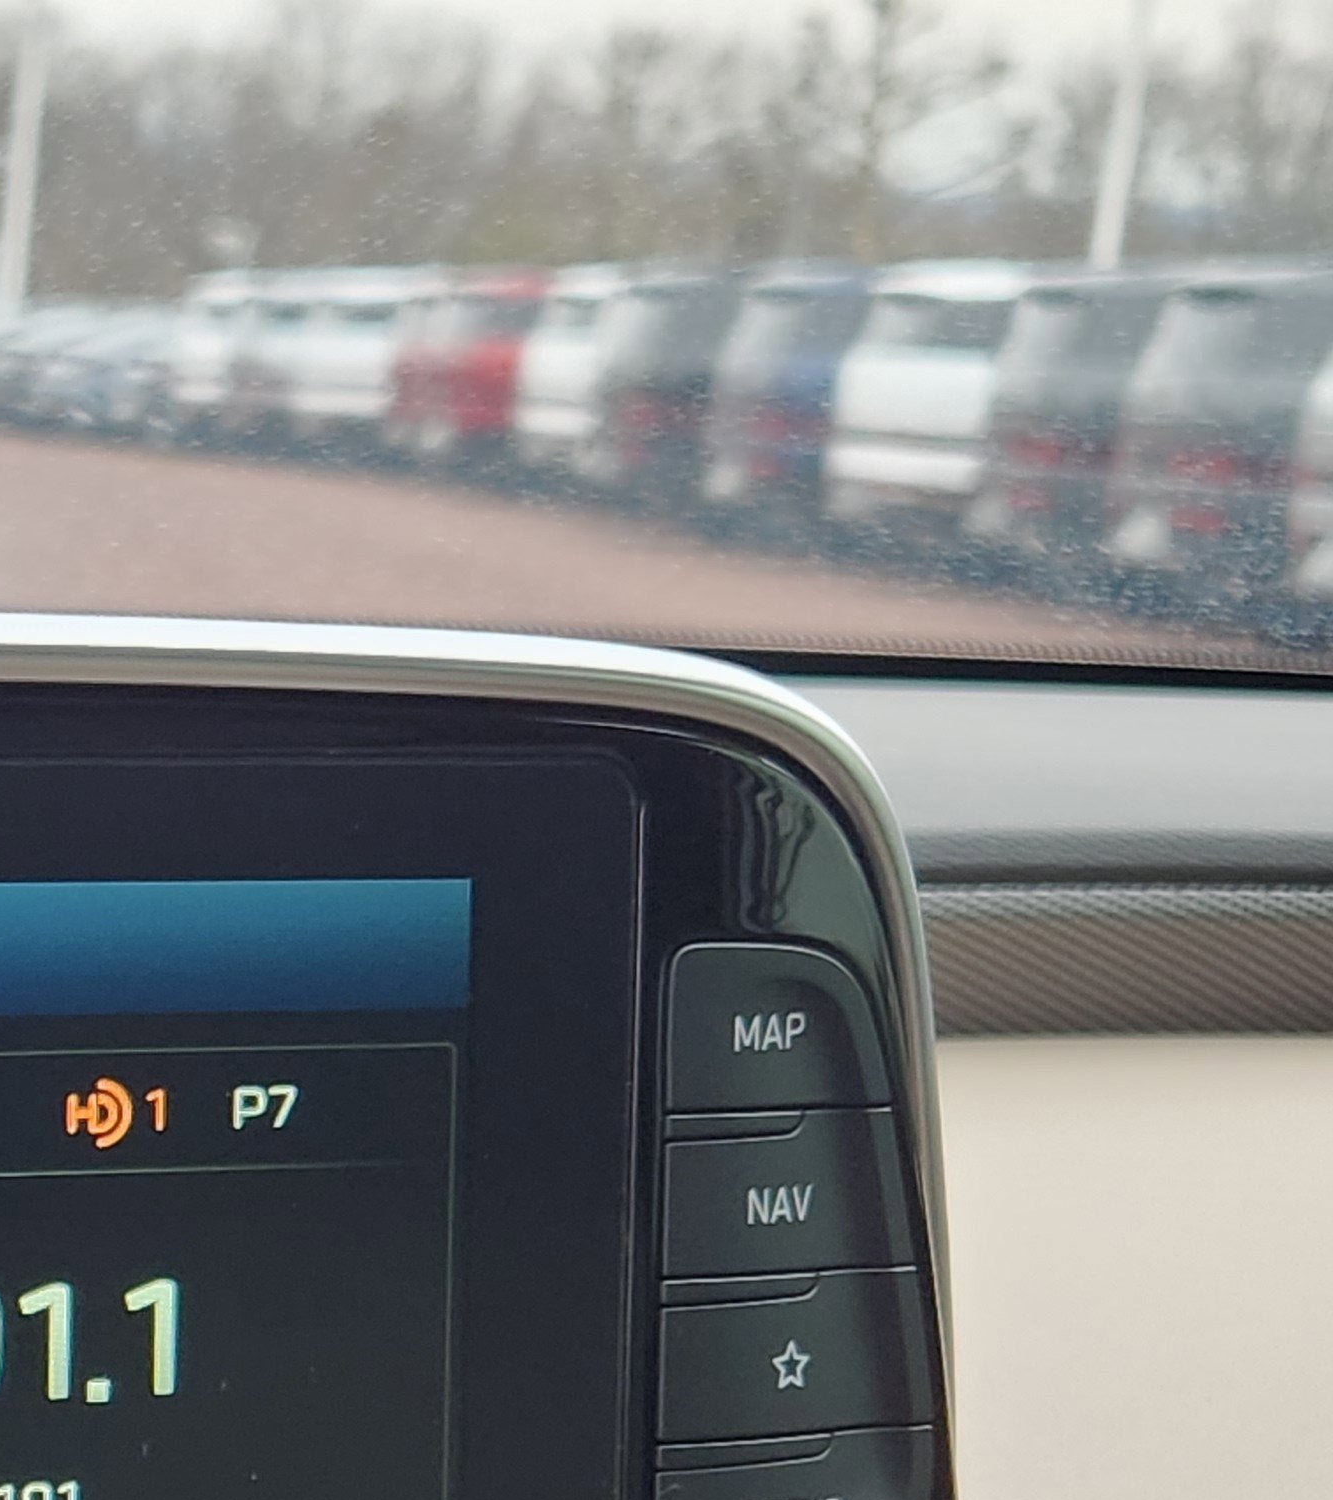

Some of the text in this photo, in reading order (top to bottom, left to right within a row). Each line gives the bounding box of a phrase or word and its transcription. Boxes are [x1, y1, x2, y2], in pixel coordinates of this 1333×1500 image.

[733, 1011, 806, 1053] MAP
[231, 1083, 299, 1131] P7
[746, 1183, 813, 1226] NAV
